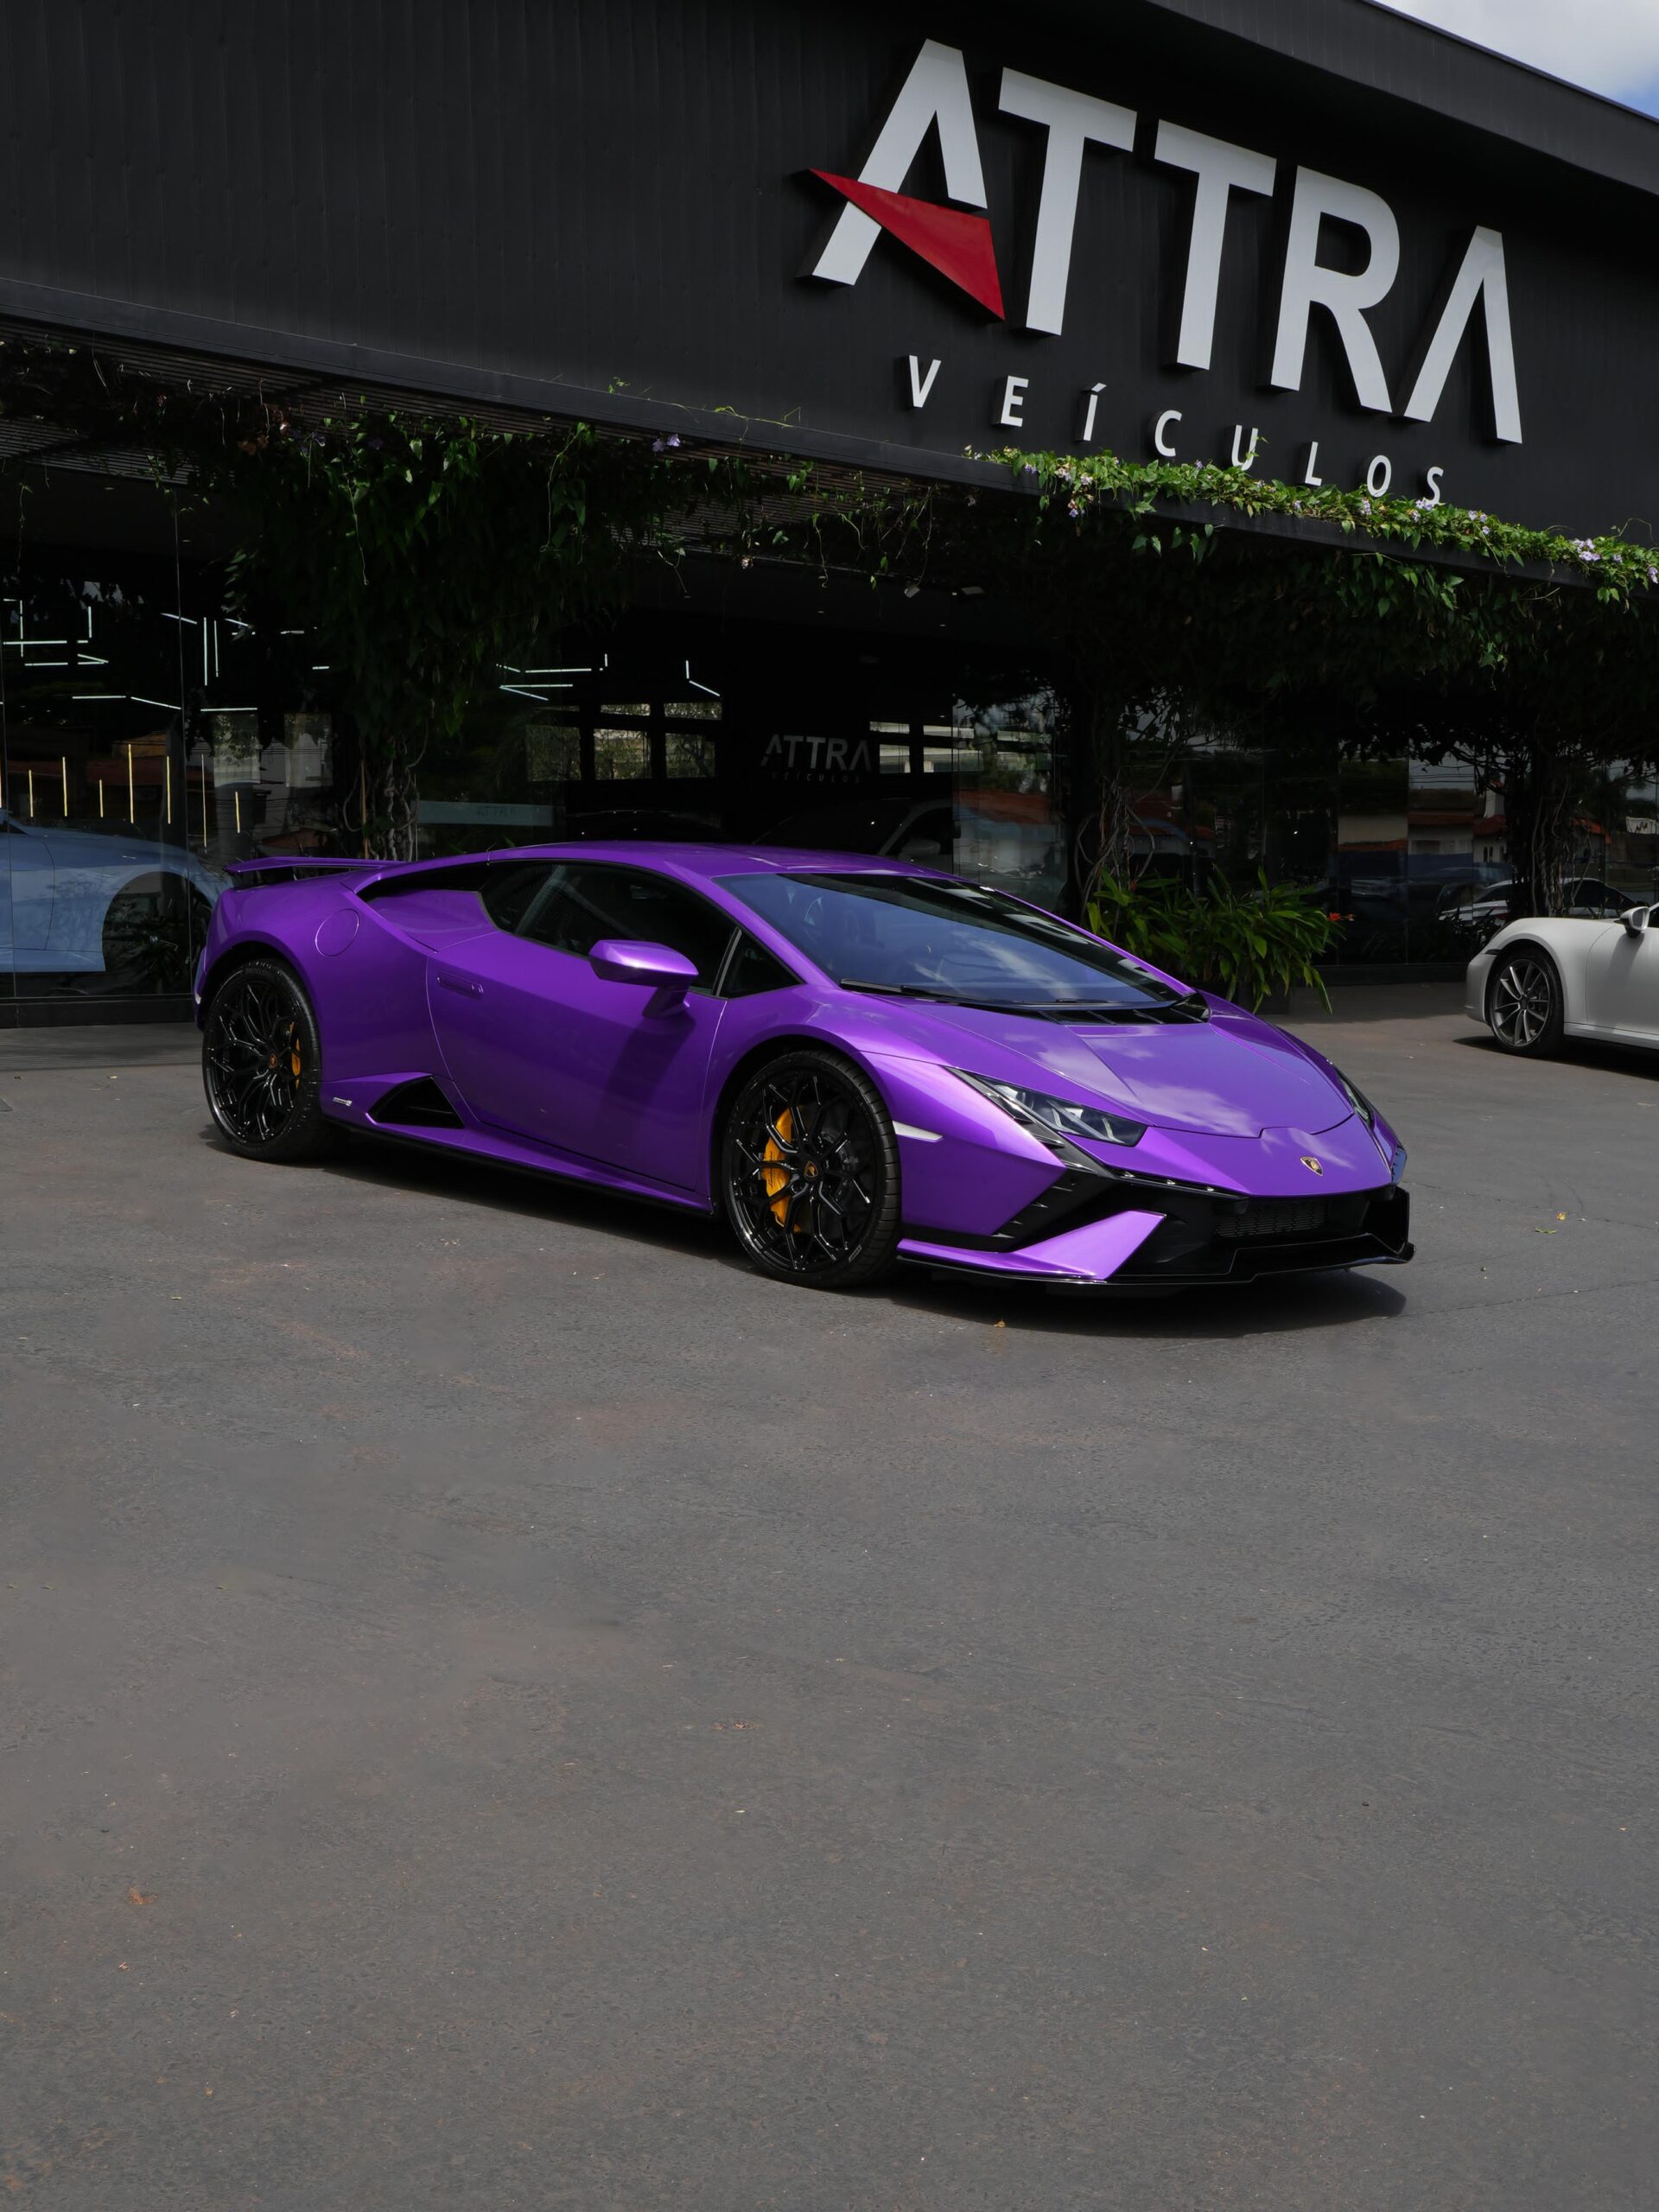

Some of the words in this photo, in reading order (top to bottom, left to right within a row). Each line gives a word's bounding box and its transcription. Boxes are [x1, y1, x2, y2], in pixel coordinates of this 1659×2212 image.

[810, 38, 1523, 444] ATTRA
[908, 354, 1444, 505] VEÍCULOS
[760, 734, 871, 772] ATTRA
